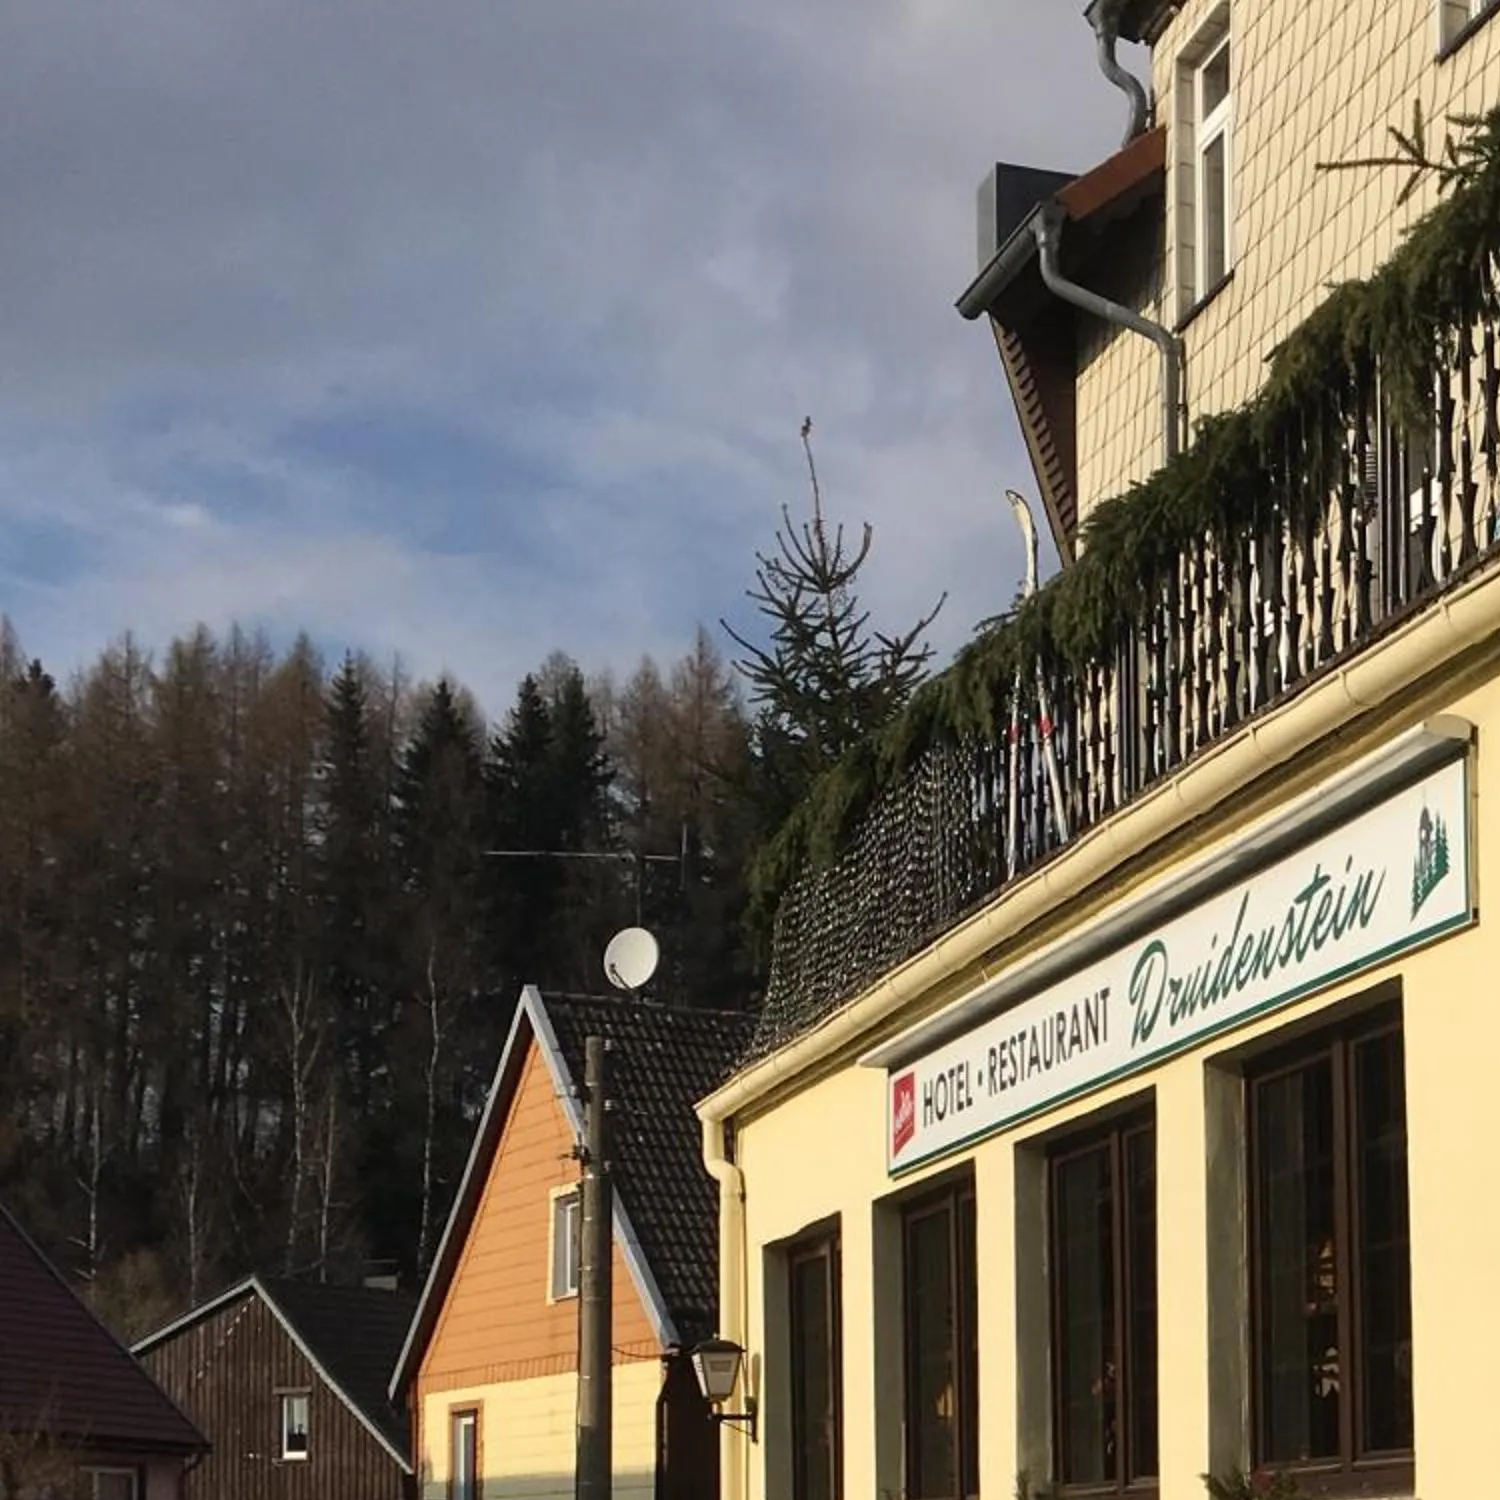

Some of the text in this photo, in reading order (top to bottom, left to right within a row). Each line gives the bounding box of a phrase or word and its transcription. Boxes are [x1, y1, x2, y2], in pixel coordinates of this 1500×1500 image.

[922, 855, 1387, 1130] HOTEL RESTAURANT Druidenstein
